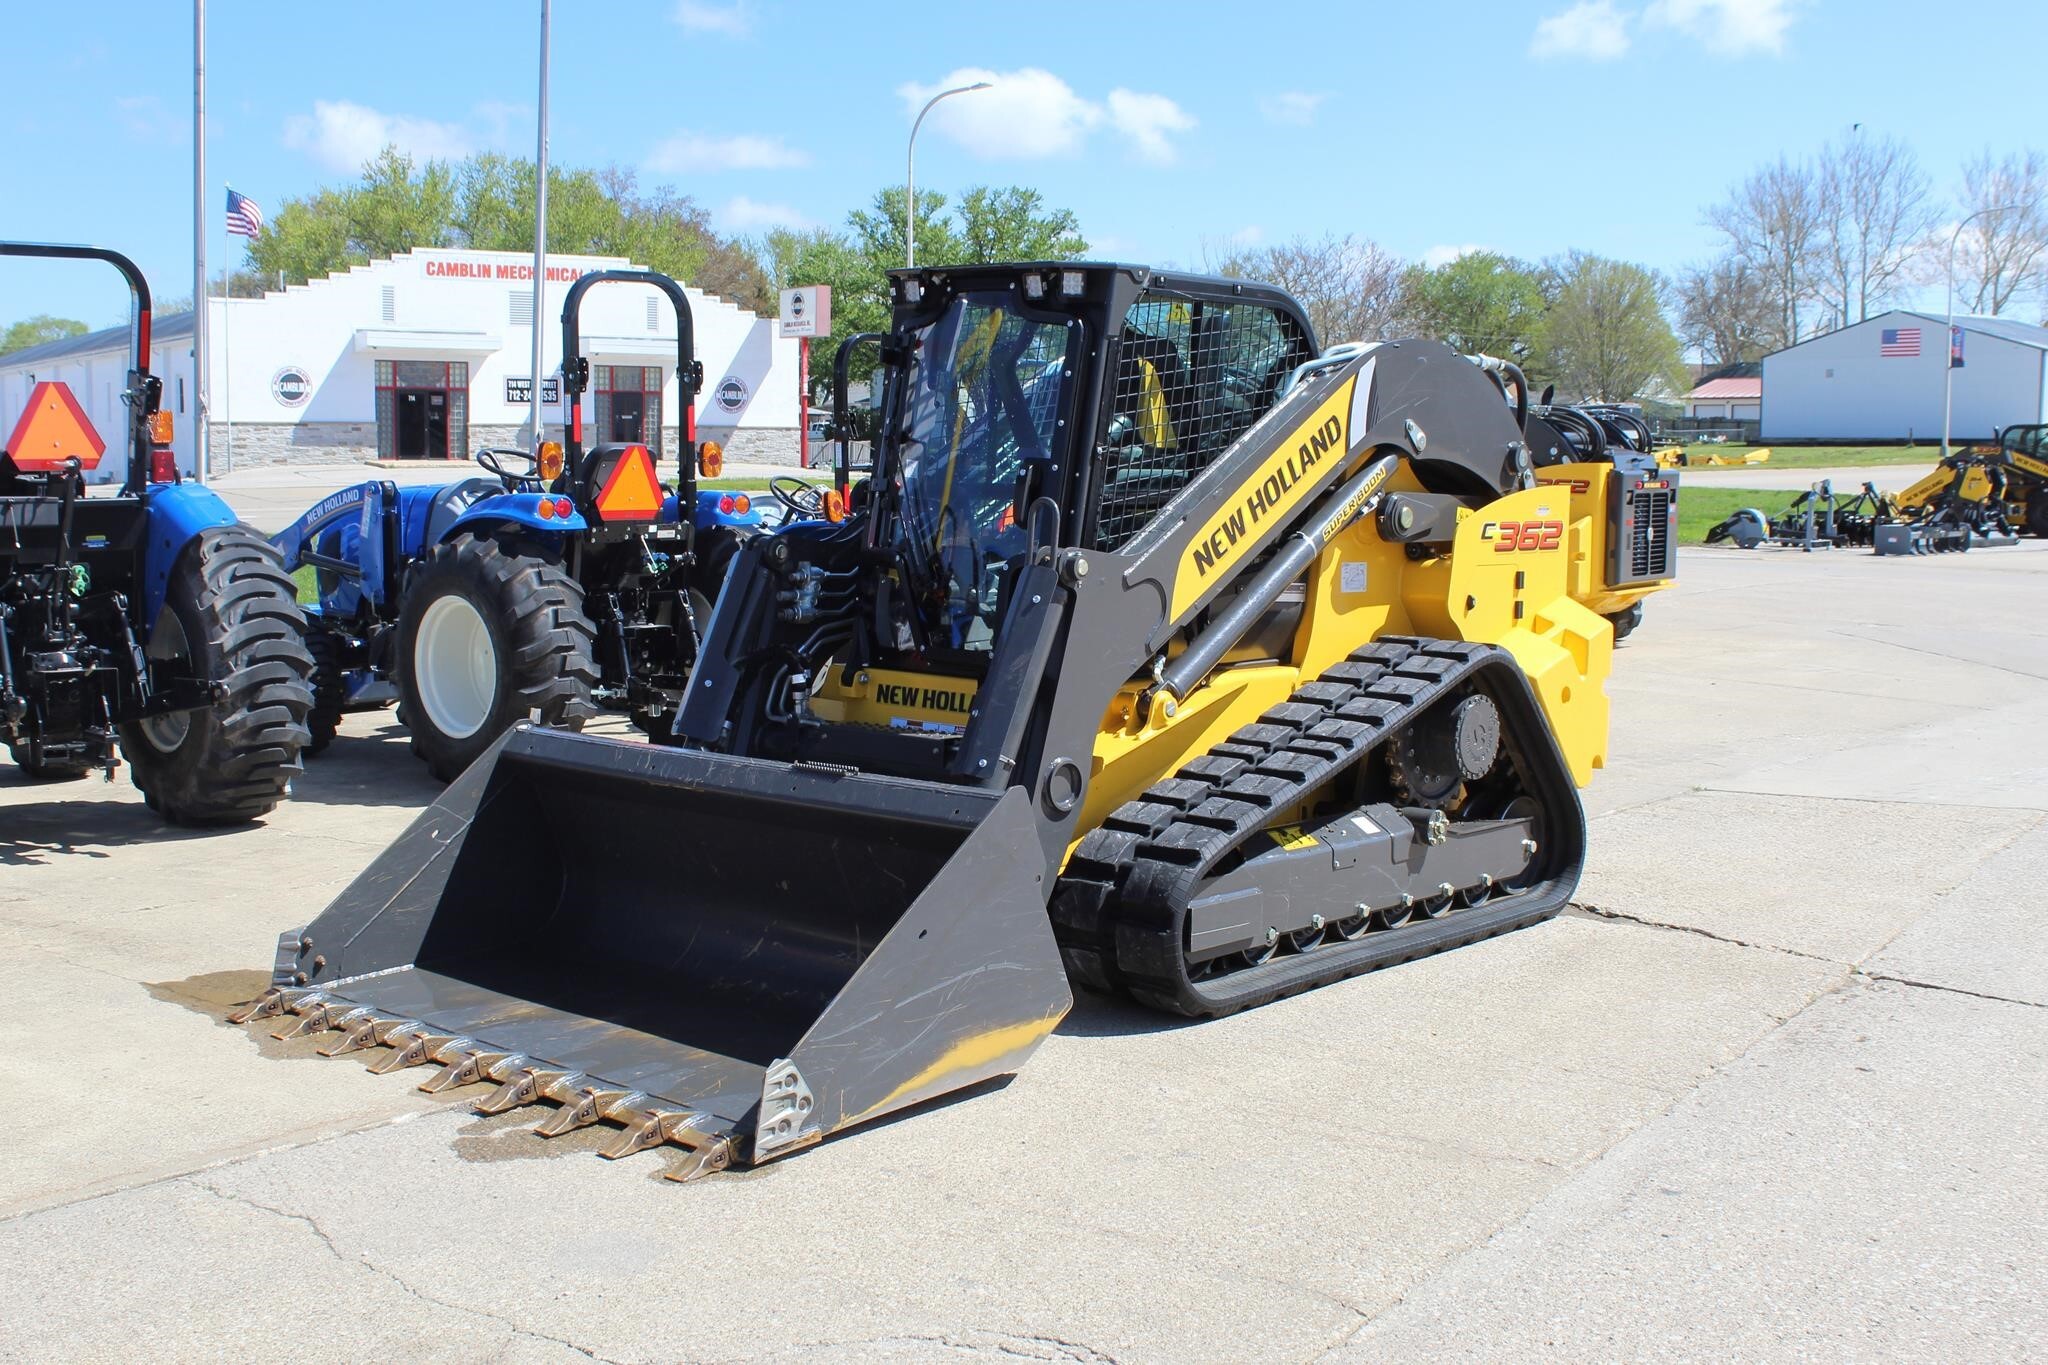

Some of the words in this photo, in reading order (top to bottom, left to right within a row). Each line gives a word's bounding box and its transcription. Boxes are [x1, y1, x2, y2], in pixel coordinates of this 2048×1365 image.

[426, 261, 491, 278] CAMBLIN
[496, 264, 585, 283] MECHNICA
[280, 382, 305, 393] CAMBLIN
[721, 390, 743, 400] CAMBLIN
[306, 504, 324, 525] NEW
[324, 489, 359, 513] HOLLAND
[1193, 507, 1247, 577] NEW
[1247, 414, 1342, 524] HOLLAND
[1481, 521, 1563, 552] C362
[877, 683, 919, 707] NEW
[922, 689, 976, 713] HOLL
